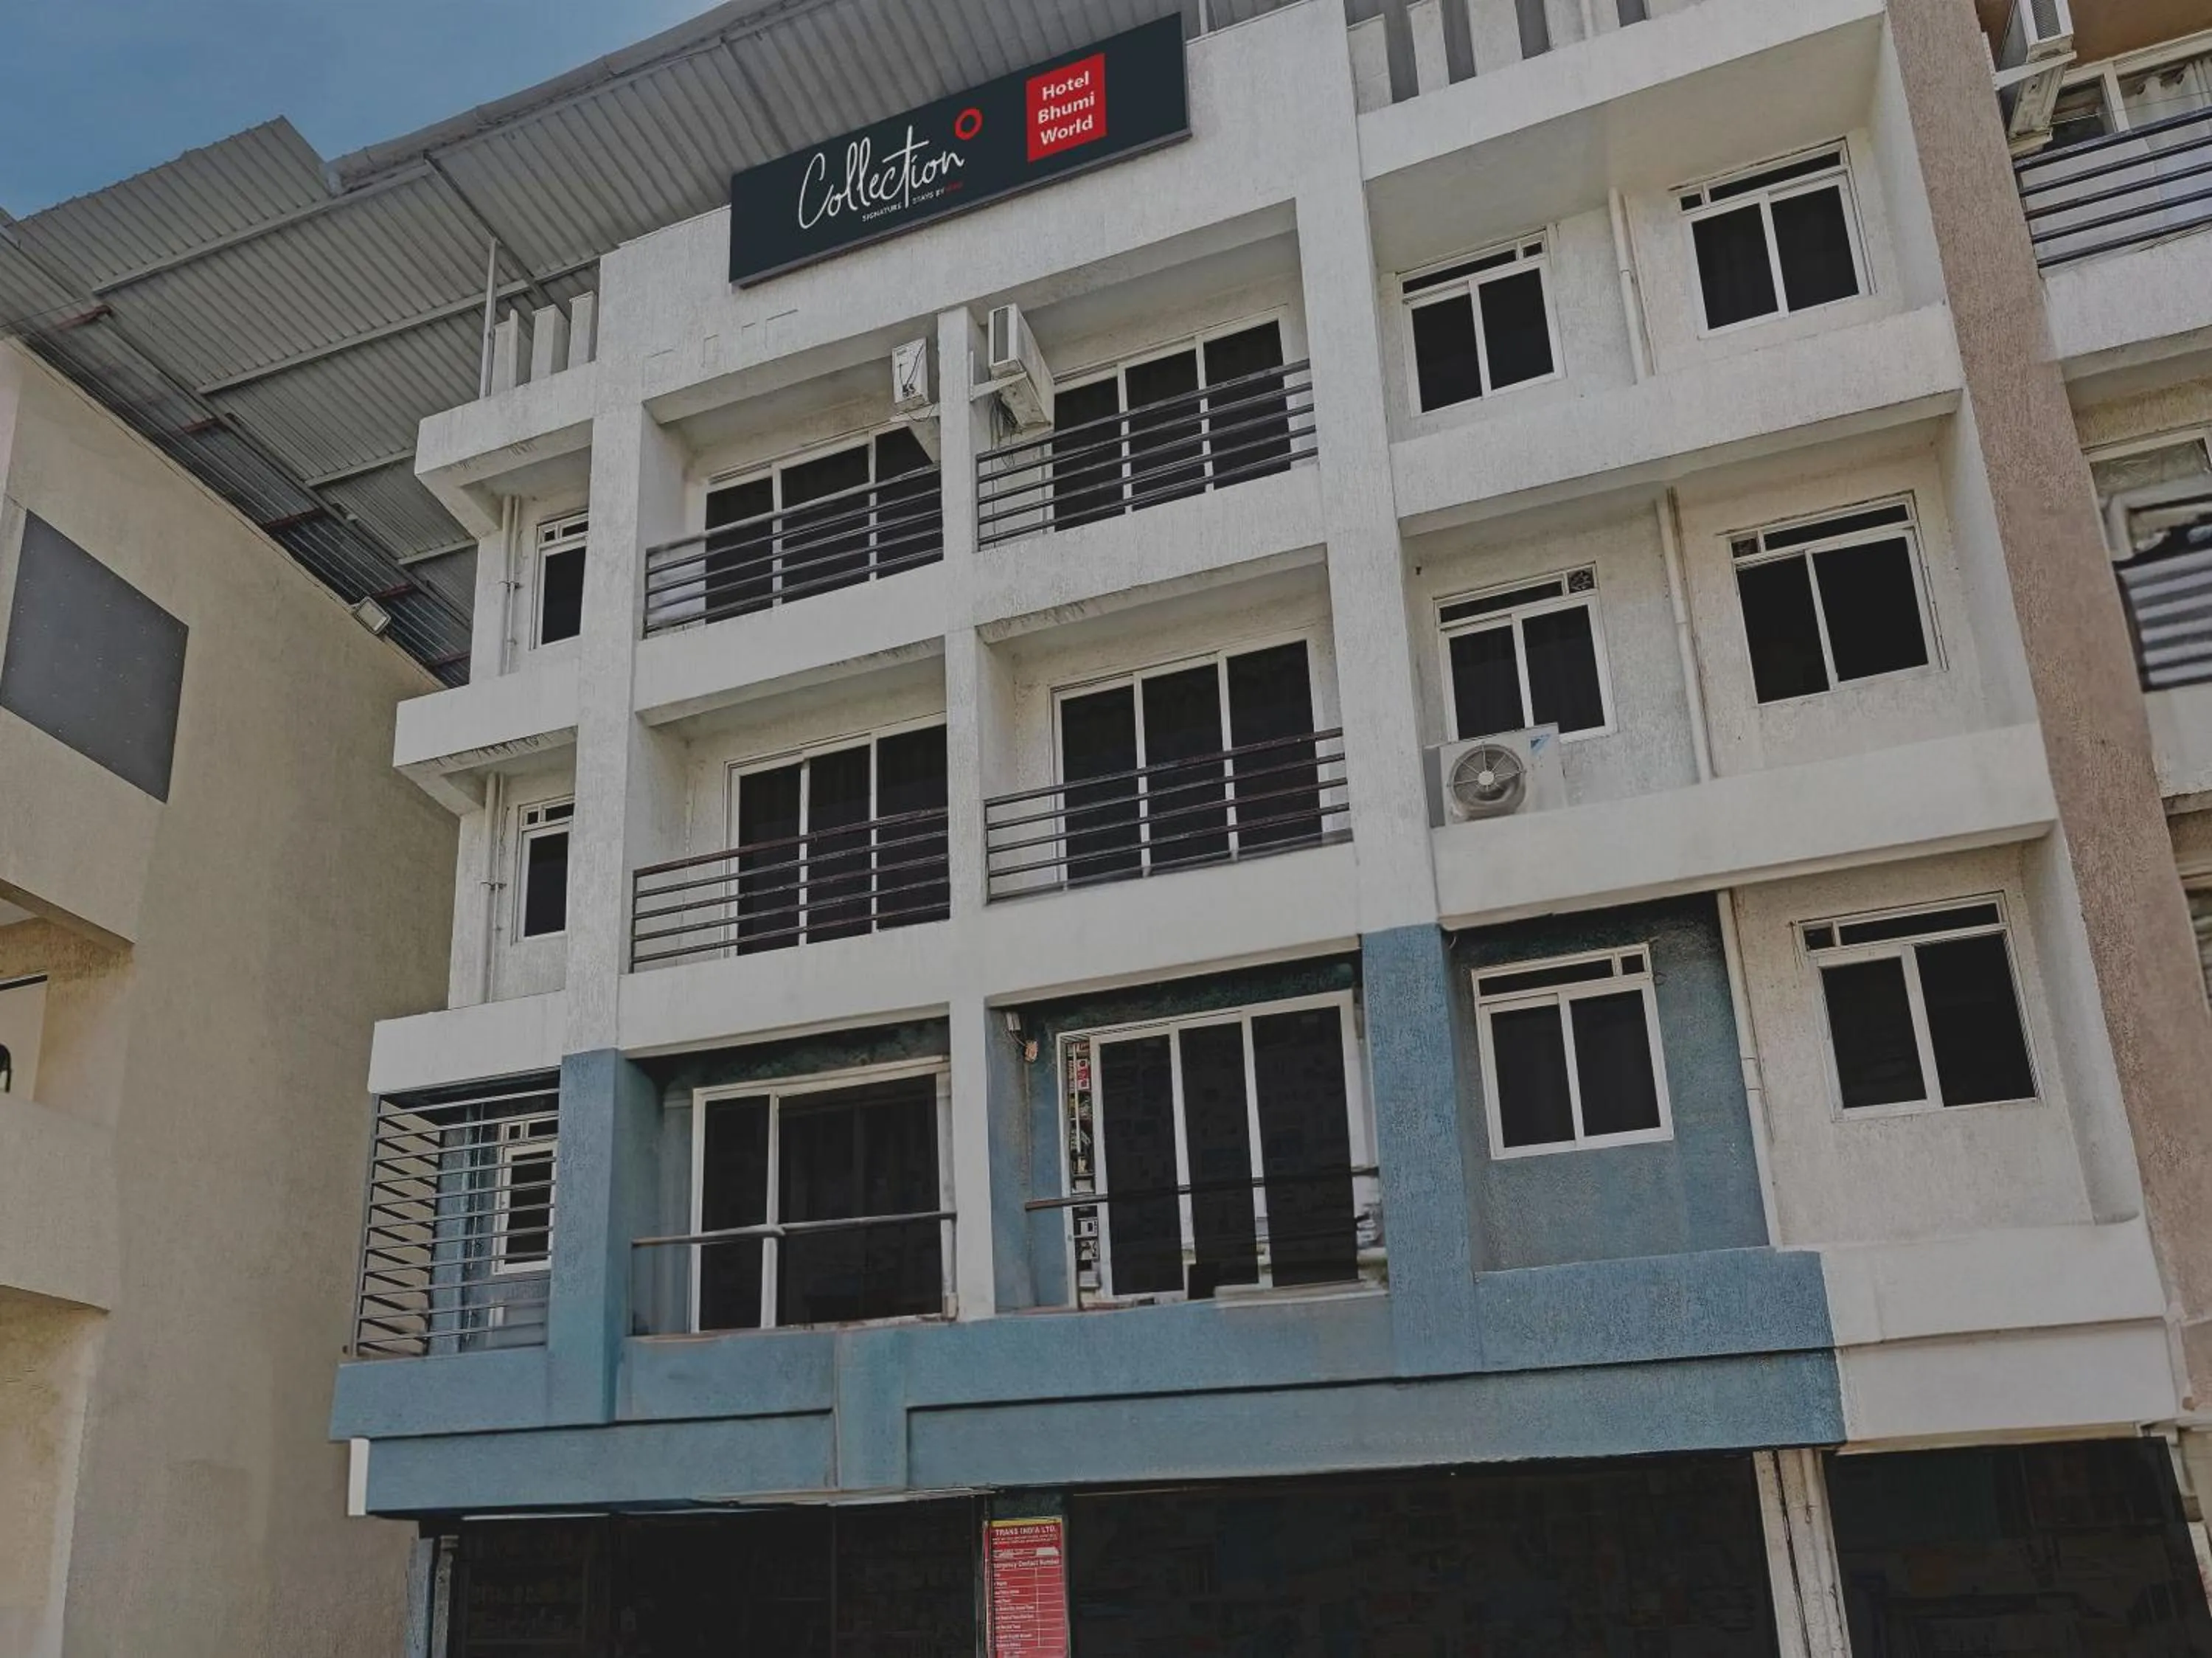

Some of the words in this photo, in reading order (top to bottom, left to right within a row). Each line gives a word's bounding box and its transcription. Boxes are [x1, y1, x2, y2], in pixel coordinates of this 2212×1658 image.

[1042, 71, 1089, 100] Hotel
[1038, 91, 1095, 124] Bhumi
[1040, 114, 1093, 145] World
[799, 125, 964, 229] Collection
[862, 202, 902, 222] SIGNATURE
